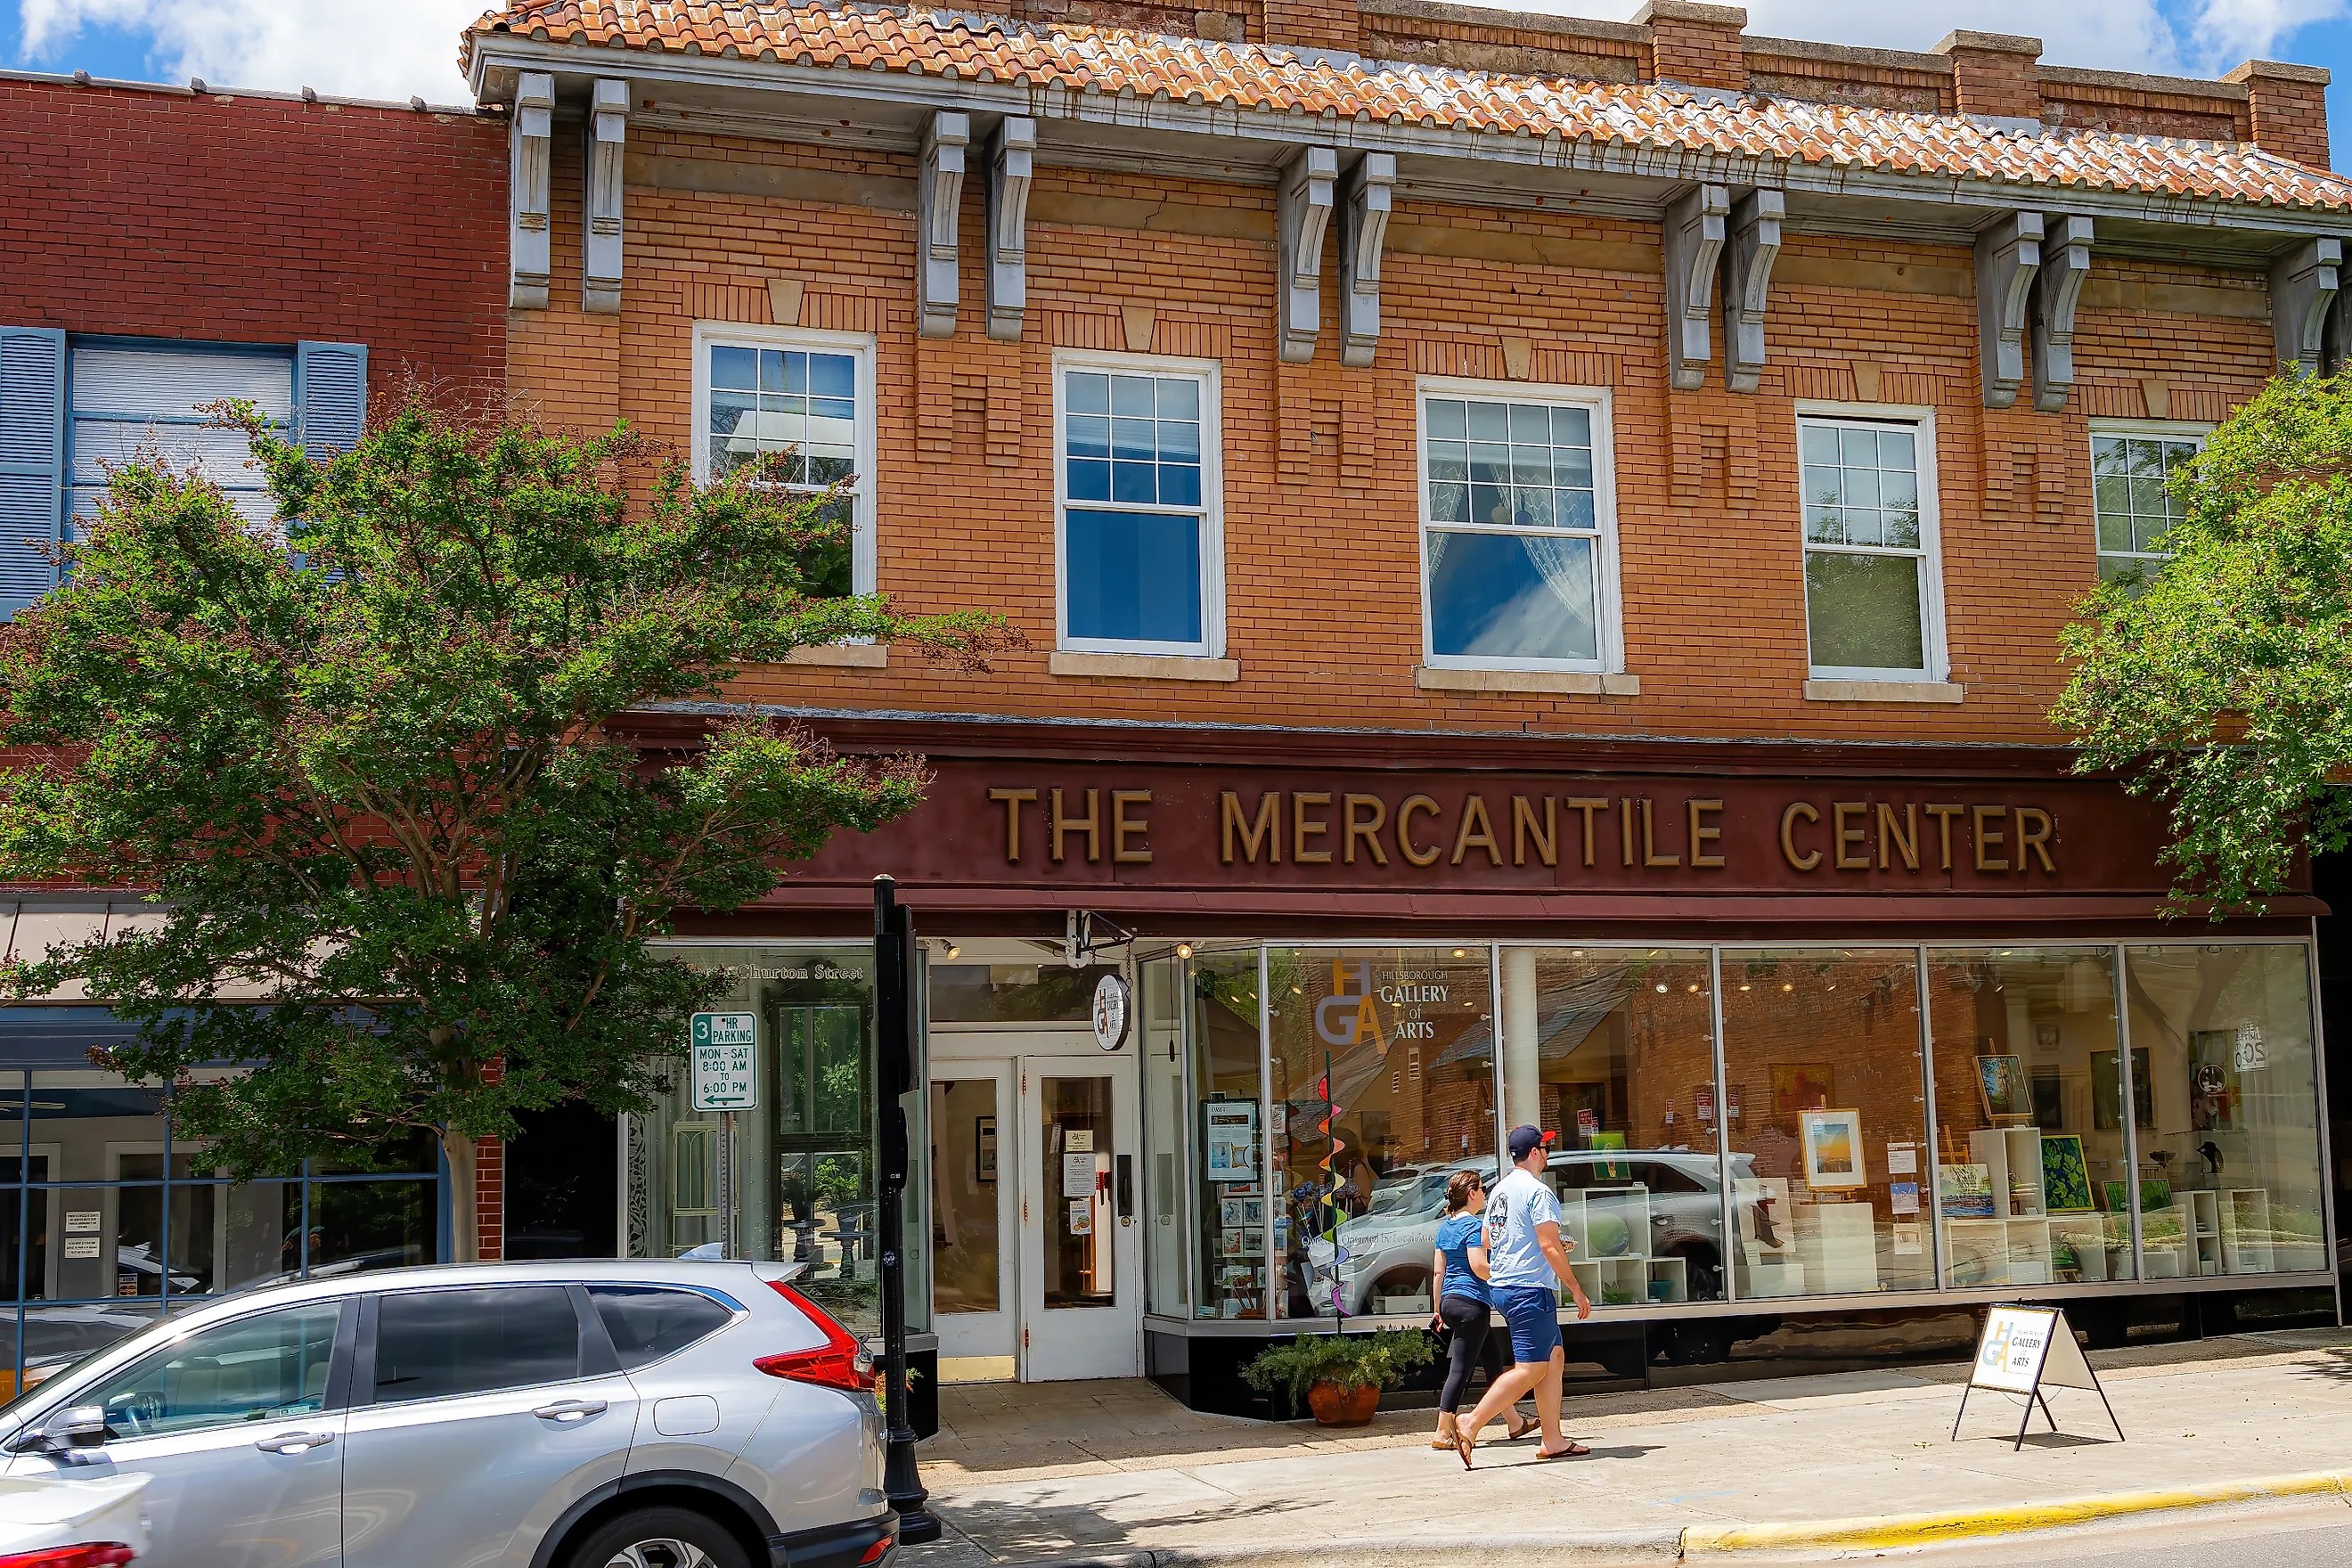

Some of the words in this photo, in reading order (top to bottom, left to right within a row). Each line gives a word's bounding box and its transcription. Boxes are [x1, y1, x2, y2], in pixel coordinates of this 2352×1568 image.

[987, 788, 1154, 863] THE
[1219, 790, 1727, 869] MERCANTILE
[1780, 801, 2057, 874] CENTER
[738, 964, 808, 979] Churton
[814, 964, 864, 979] Street
[1382, 969, 1448, 980] HILLSBOROUGH
[1380, 984, 1450, 1003] GALLERY
[1409, 1003, 1422, 1019] of
[695, 1021, 709, 1040] 3
[726, 1017, 739, 1030] HR
[1394, 1021, 1434, 1039] ARTS
[713, 1030, 752, 1042] PARKING
[699, 1049, 721, 1059] MON
[731, 1048, 748, 1058] SAT
[702, 1061, 726, 1072] 8:00
[731, 1060, 747, 1071] AM
[720, 1072, 730, 1081] TO
[703, 1082, 727, 1093] 6:00
[732, 1082, 747, 1092] PM
[2012, 1336, 2042, 1349] GALLERY
[2011, 1357, 2030, 1367] ARTS
